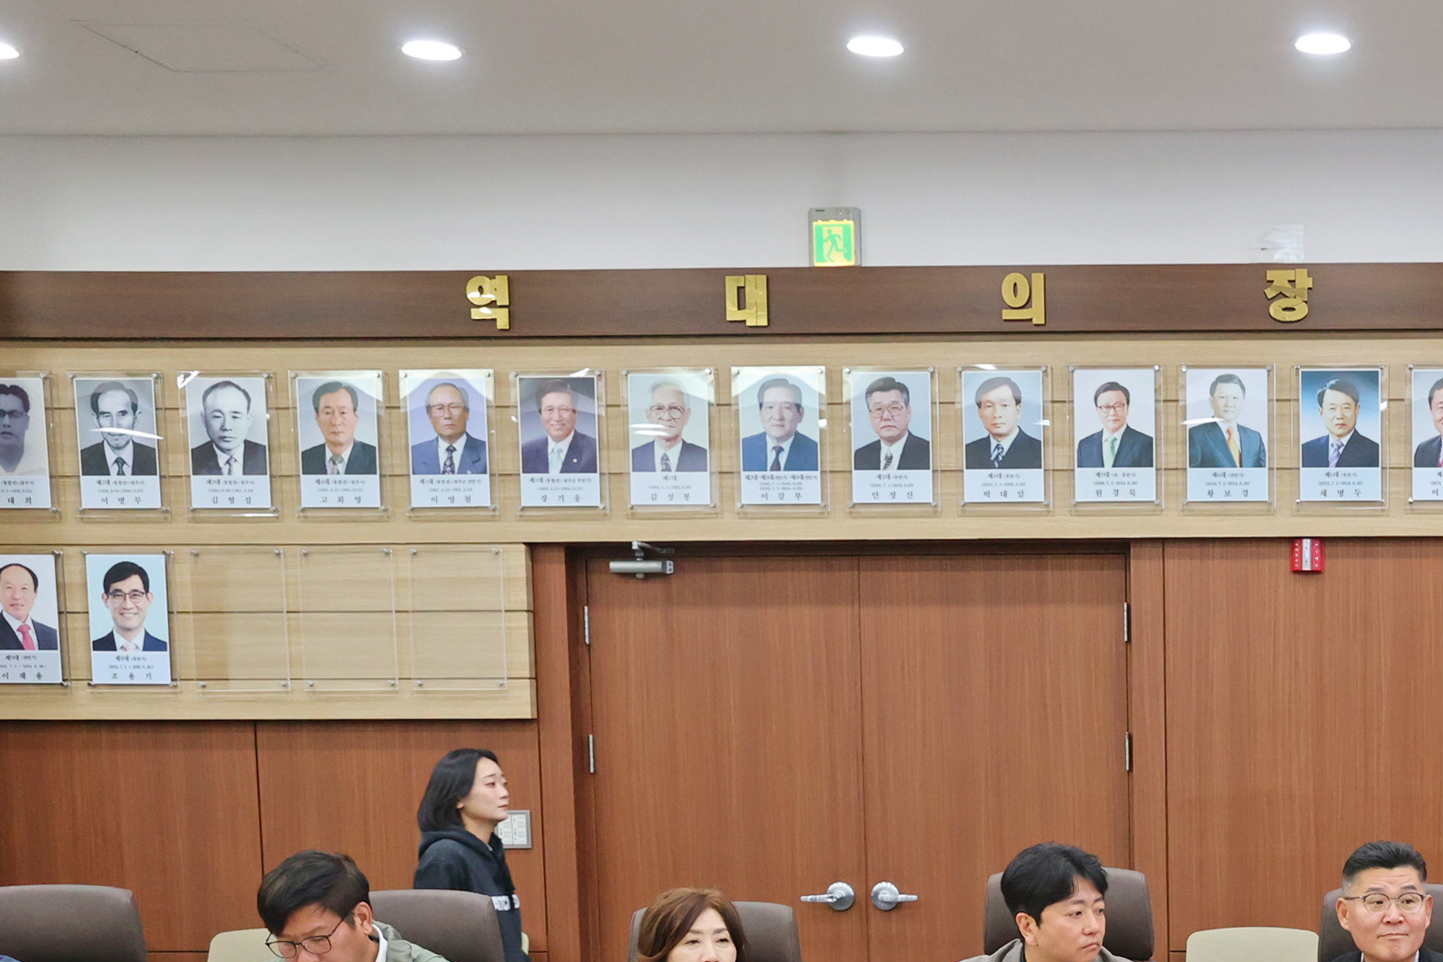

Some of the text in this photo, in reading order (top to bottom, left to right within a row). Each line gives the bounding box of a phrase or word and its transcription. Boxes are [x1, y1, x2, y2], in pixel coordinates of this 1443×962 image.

[465, 268, 1313, 330] 역 대 의 장
